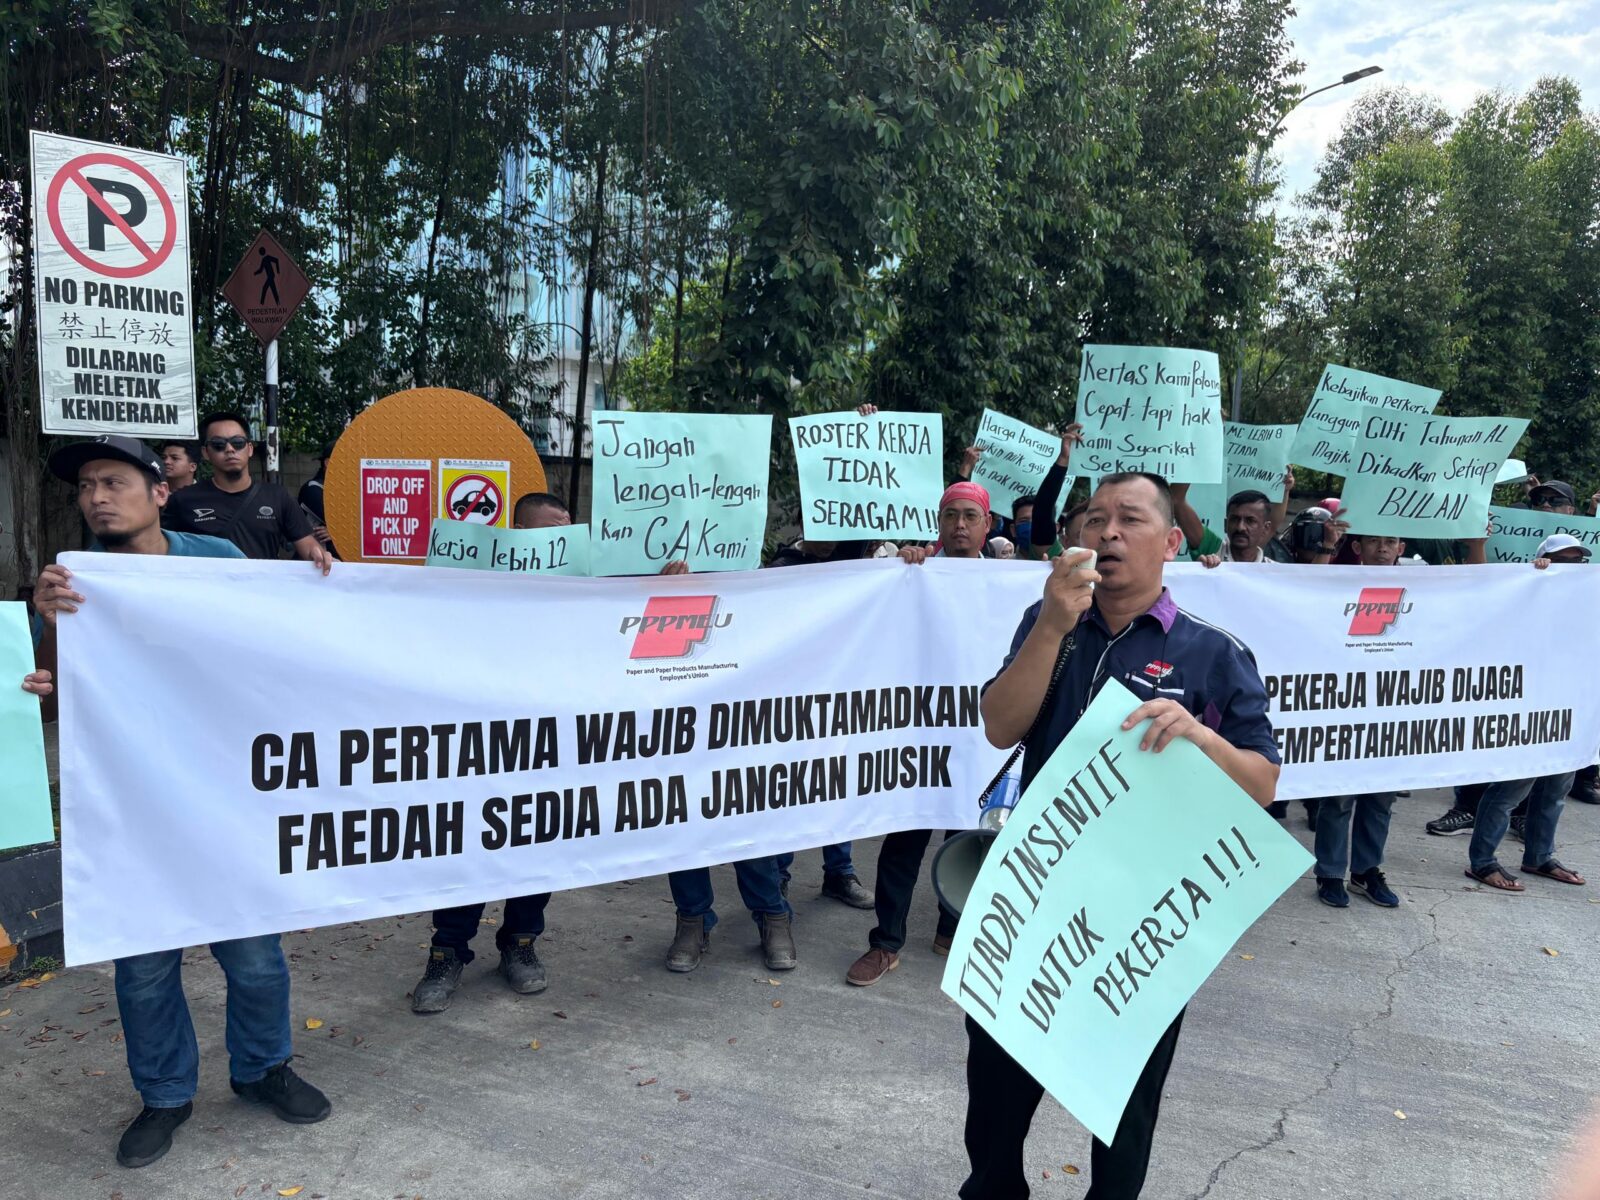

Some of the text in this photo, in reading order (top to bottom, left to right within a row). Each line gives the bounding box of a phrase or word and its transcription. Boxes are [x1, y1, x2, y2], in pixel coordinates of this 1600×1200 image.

[44, 277, 184, 316] NO PARKING
[58, 311, 175, 346] 禁止停放
[66, 346, 166, 374] DILARANG
[74, 373, 161, 399] MELETAK
[62, 399, 178, 424] KENDERAAN
[1306, 398, 1360, 437] Tanggun
[597, 420, 695, 469] Jangan
[796, 421, 931, 455] ROSTER KERJA
[982, 414, 1055, 457] Harga barang
[1117, 434, 1196, 458] Syarikat
[1483, 424, 1509, 443] AL
[367, 477, 424, 495] DROP OFF
[823, 457, 900, 489] TIDAK
[1444, 456, 1497, 486] Setiap
[383, 498, 408, 515] AND
[1378, 486, 1468, 521] BULAN
[372, 517, 419, 535] PICK UP
[1486, 515, 1544, 538] Suara
[381, 538, 411, 555] ONLY
[491, 538, 540, 572] lebih
[547, 537, 568, 569] 12
[660, 673, 692, 682] Employee's
[673, 665, 697, 673] Products
[698, 662, 738, 671] Manufacturing
[1265, 664, 1523, 712] PEKERJA WAJIB DIJAGA
[251, 685, 979, 792] CA PERTAMA WAJIB DIMUKTAMADKAN
[1472, 708, 1572, 750] KEBAJIKAN
[278, 745, 952, 875] FAEDAH SEDIA ADA JANGKAN DIUSIK
[959, 738, 1130, 1020] TIADA INSENTIF
[1093, 877, 1212, 1016] PEKERJA
[1020, 906, 1104, 1034] UNTUK
